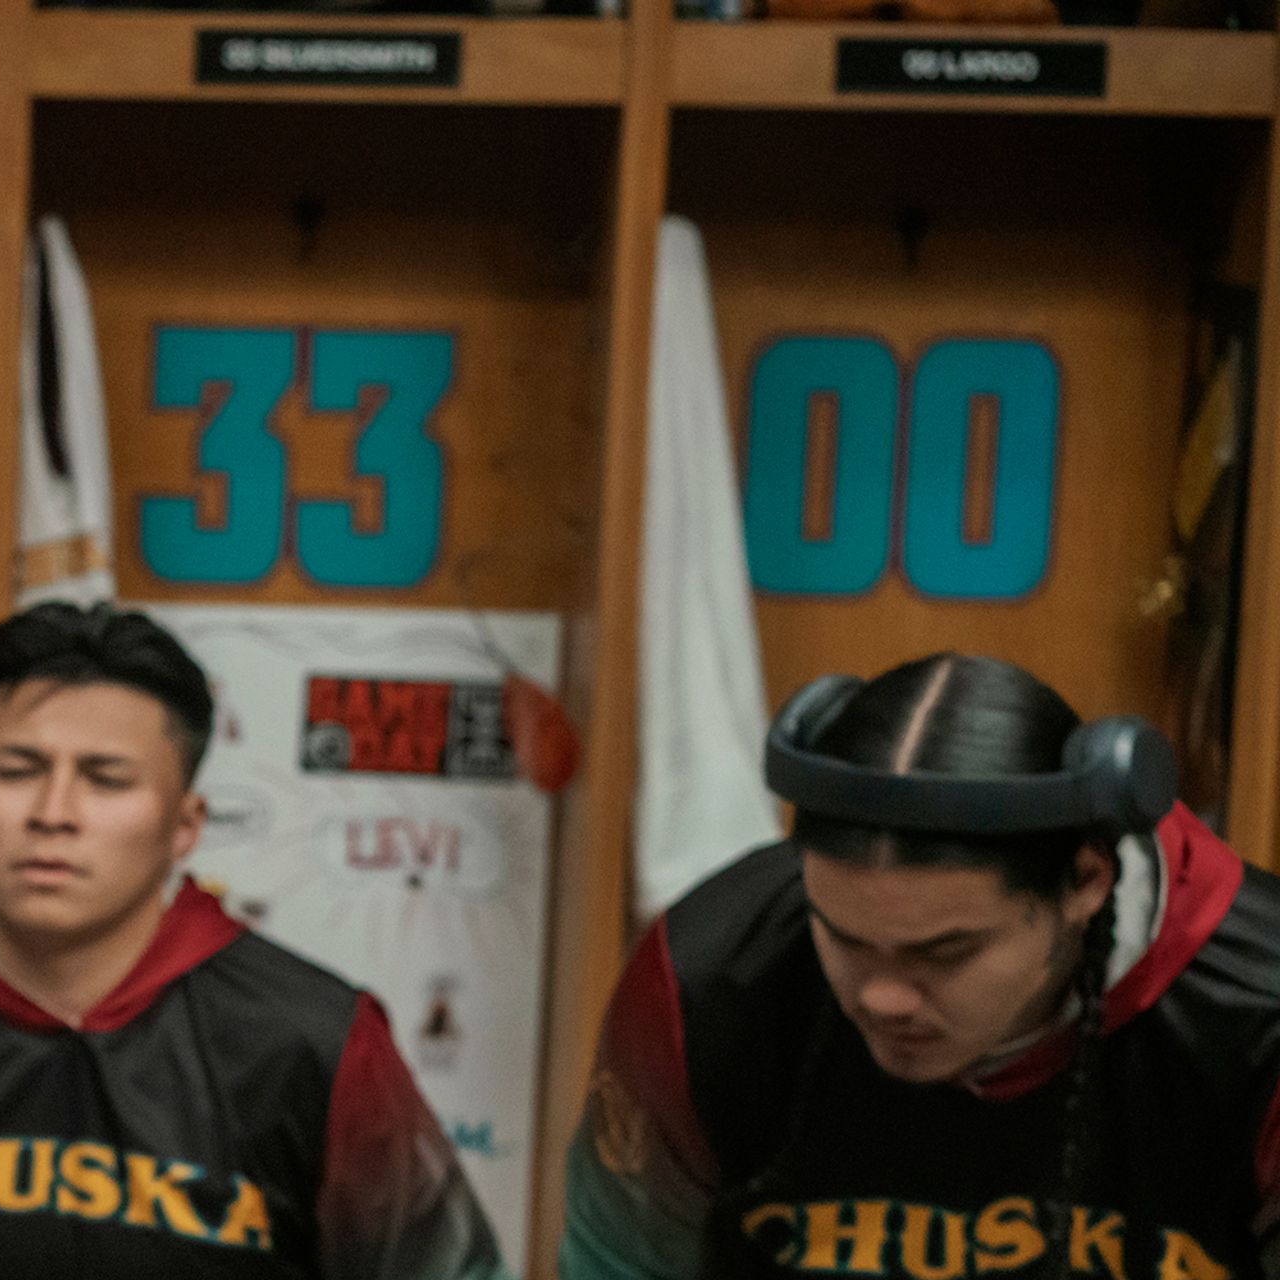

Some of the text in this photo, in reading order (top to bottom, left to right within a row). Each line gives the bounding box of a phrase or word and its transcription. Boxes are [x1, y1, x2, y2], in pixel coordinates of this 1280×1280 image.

[138, 325, 454, 588] 33
[744, 333, 1061, 597] 00
[345, 817, 462, 872] LEVI
